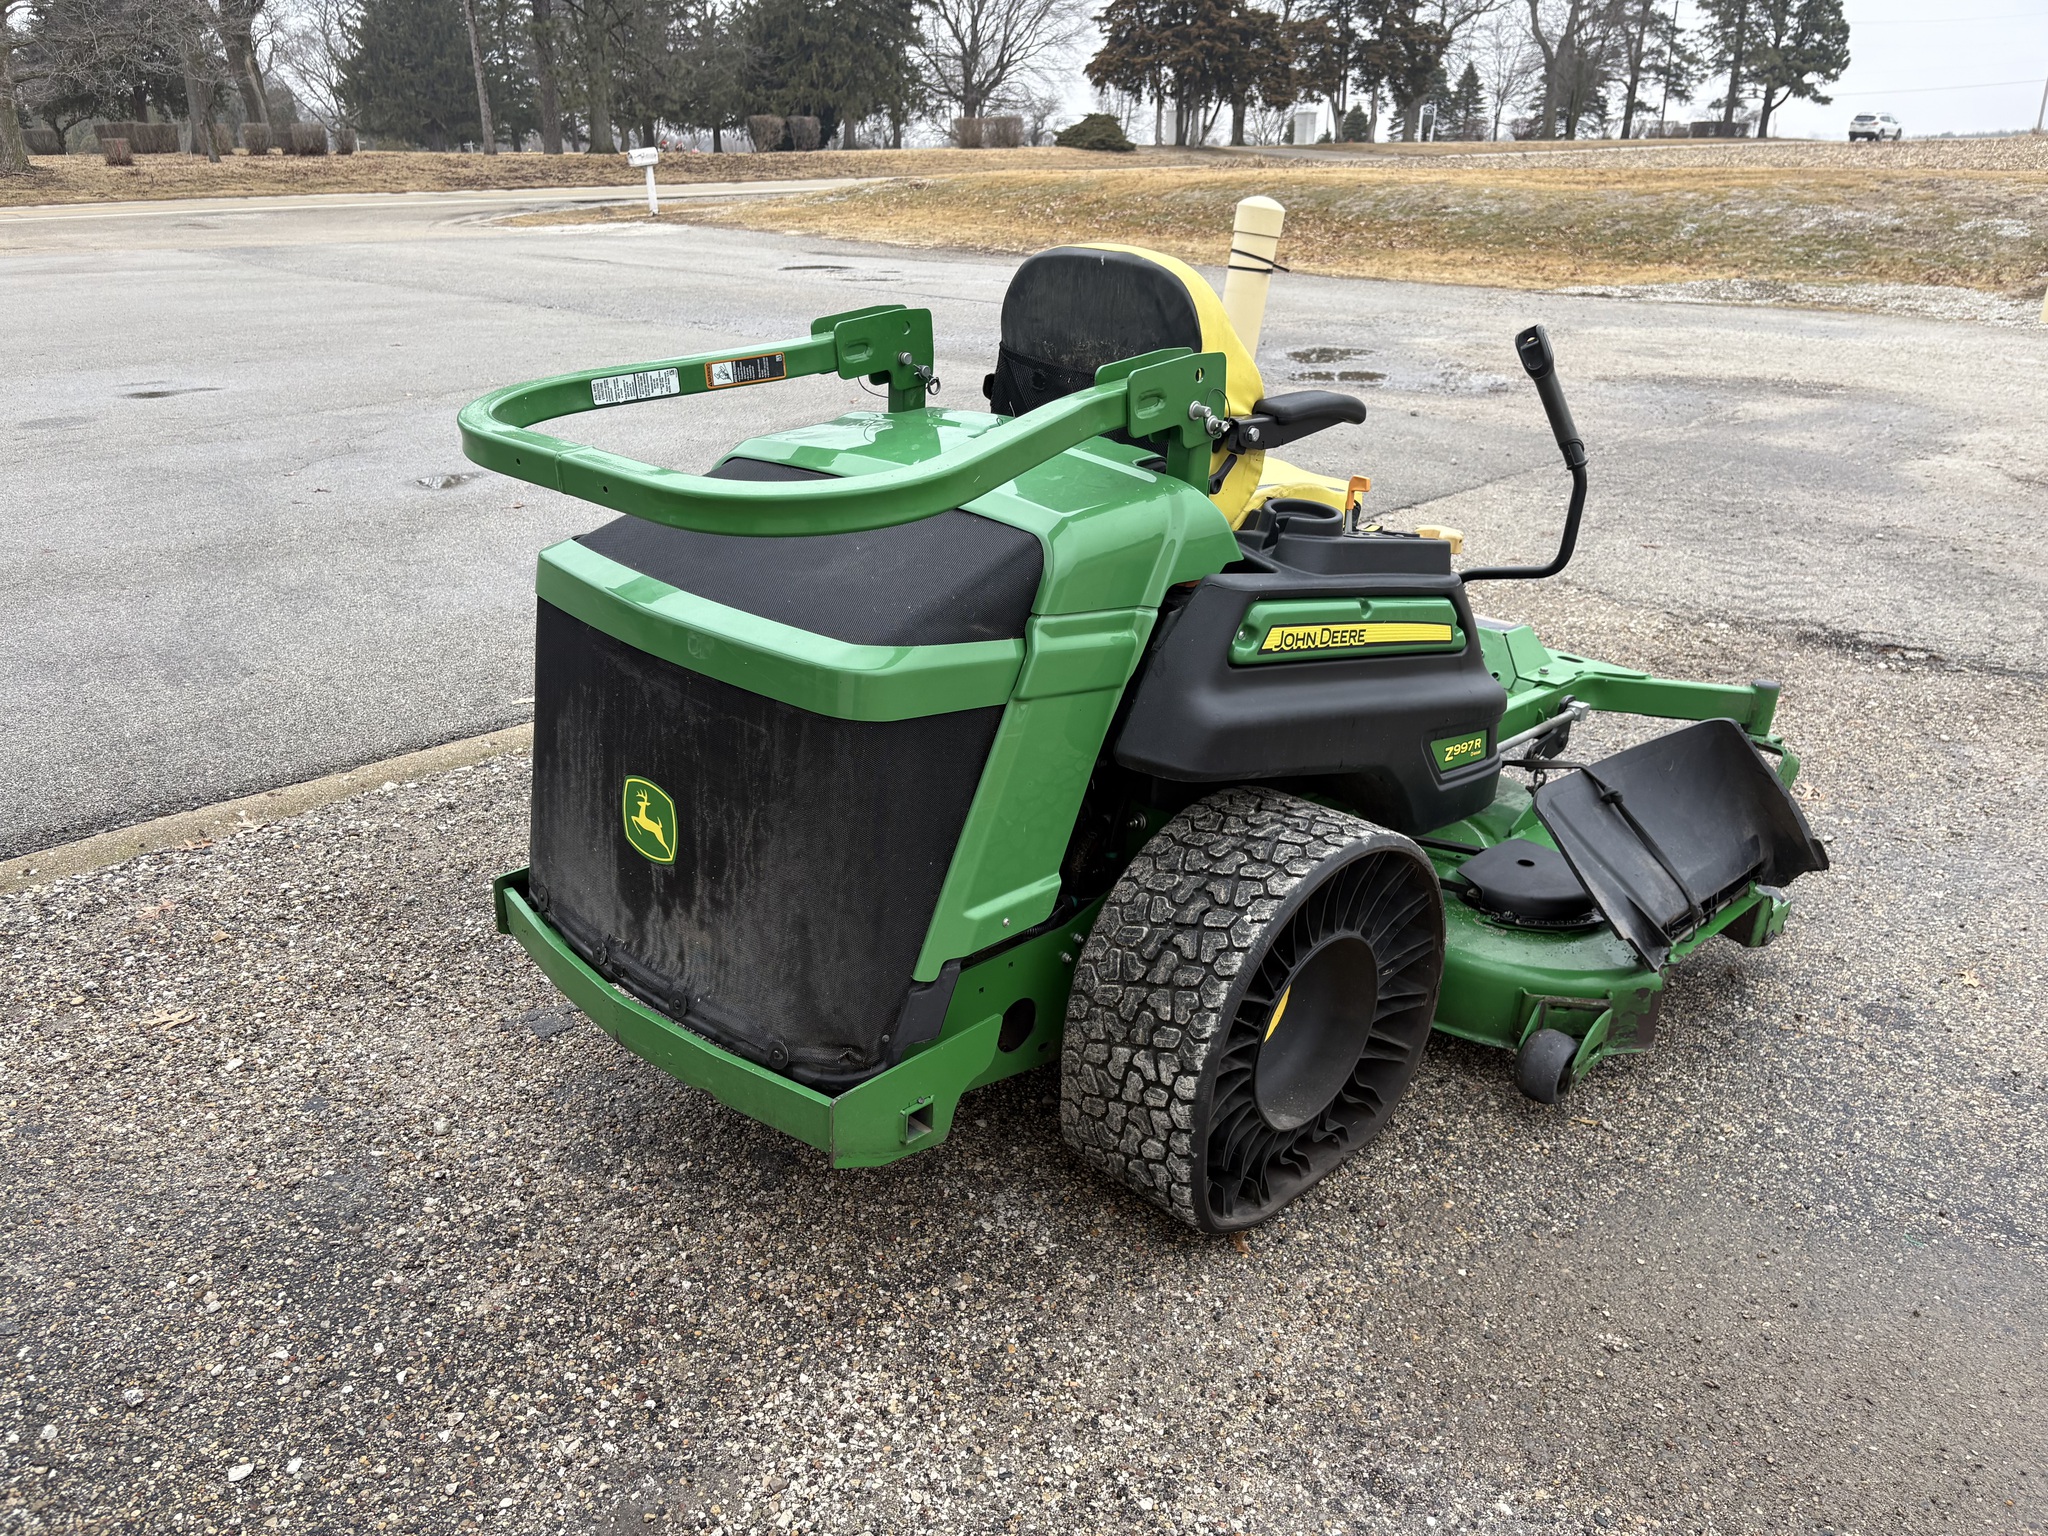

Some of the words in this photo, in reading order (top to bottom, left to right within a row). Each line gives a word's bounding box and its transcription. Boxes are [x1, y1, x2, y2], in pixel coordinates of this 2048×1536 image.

[1274, 630, 1317, 649] JOHN
[1320, 628, 1367, 645] DEERE
[1444, 737, 1482, 762] Z997R
